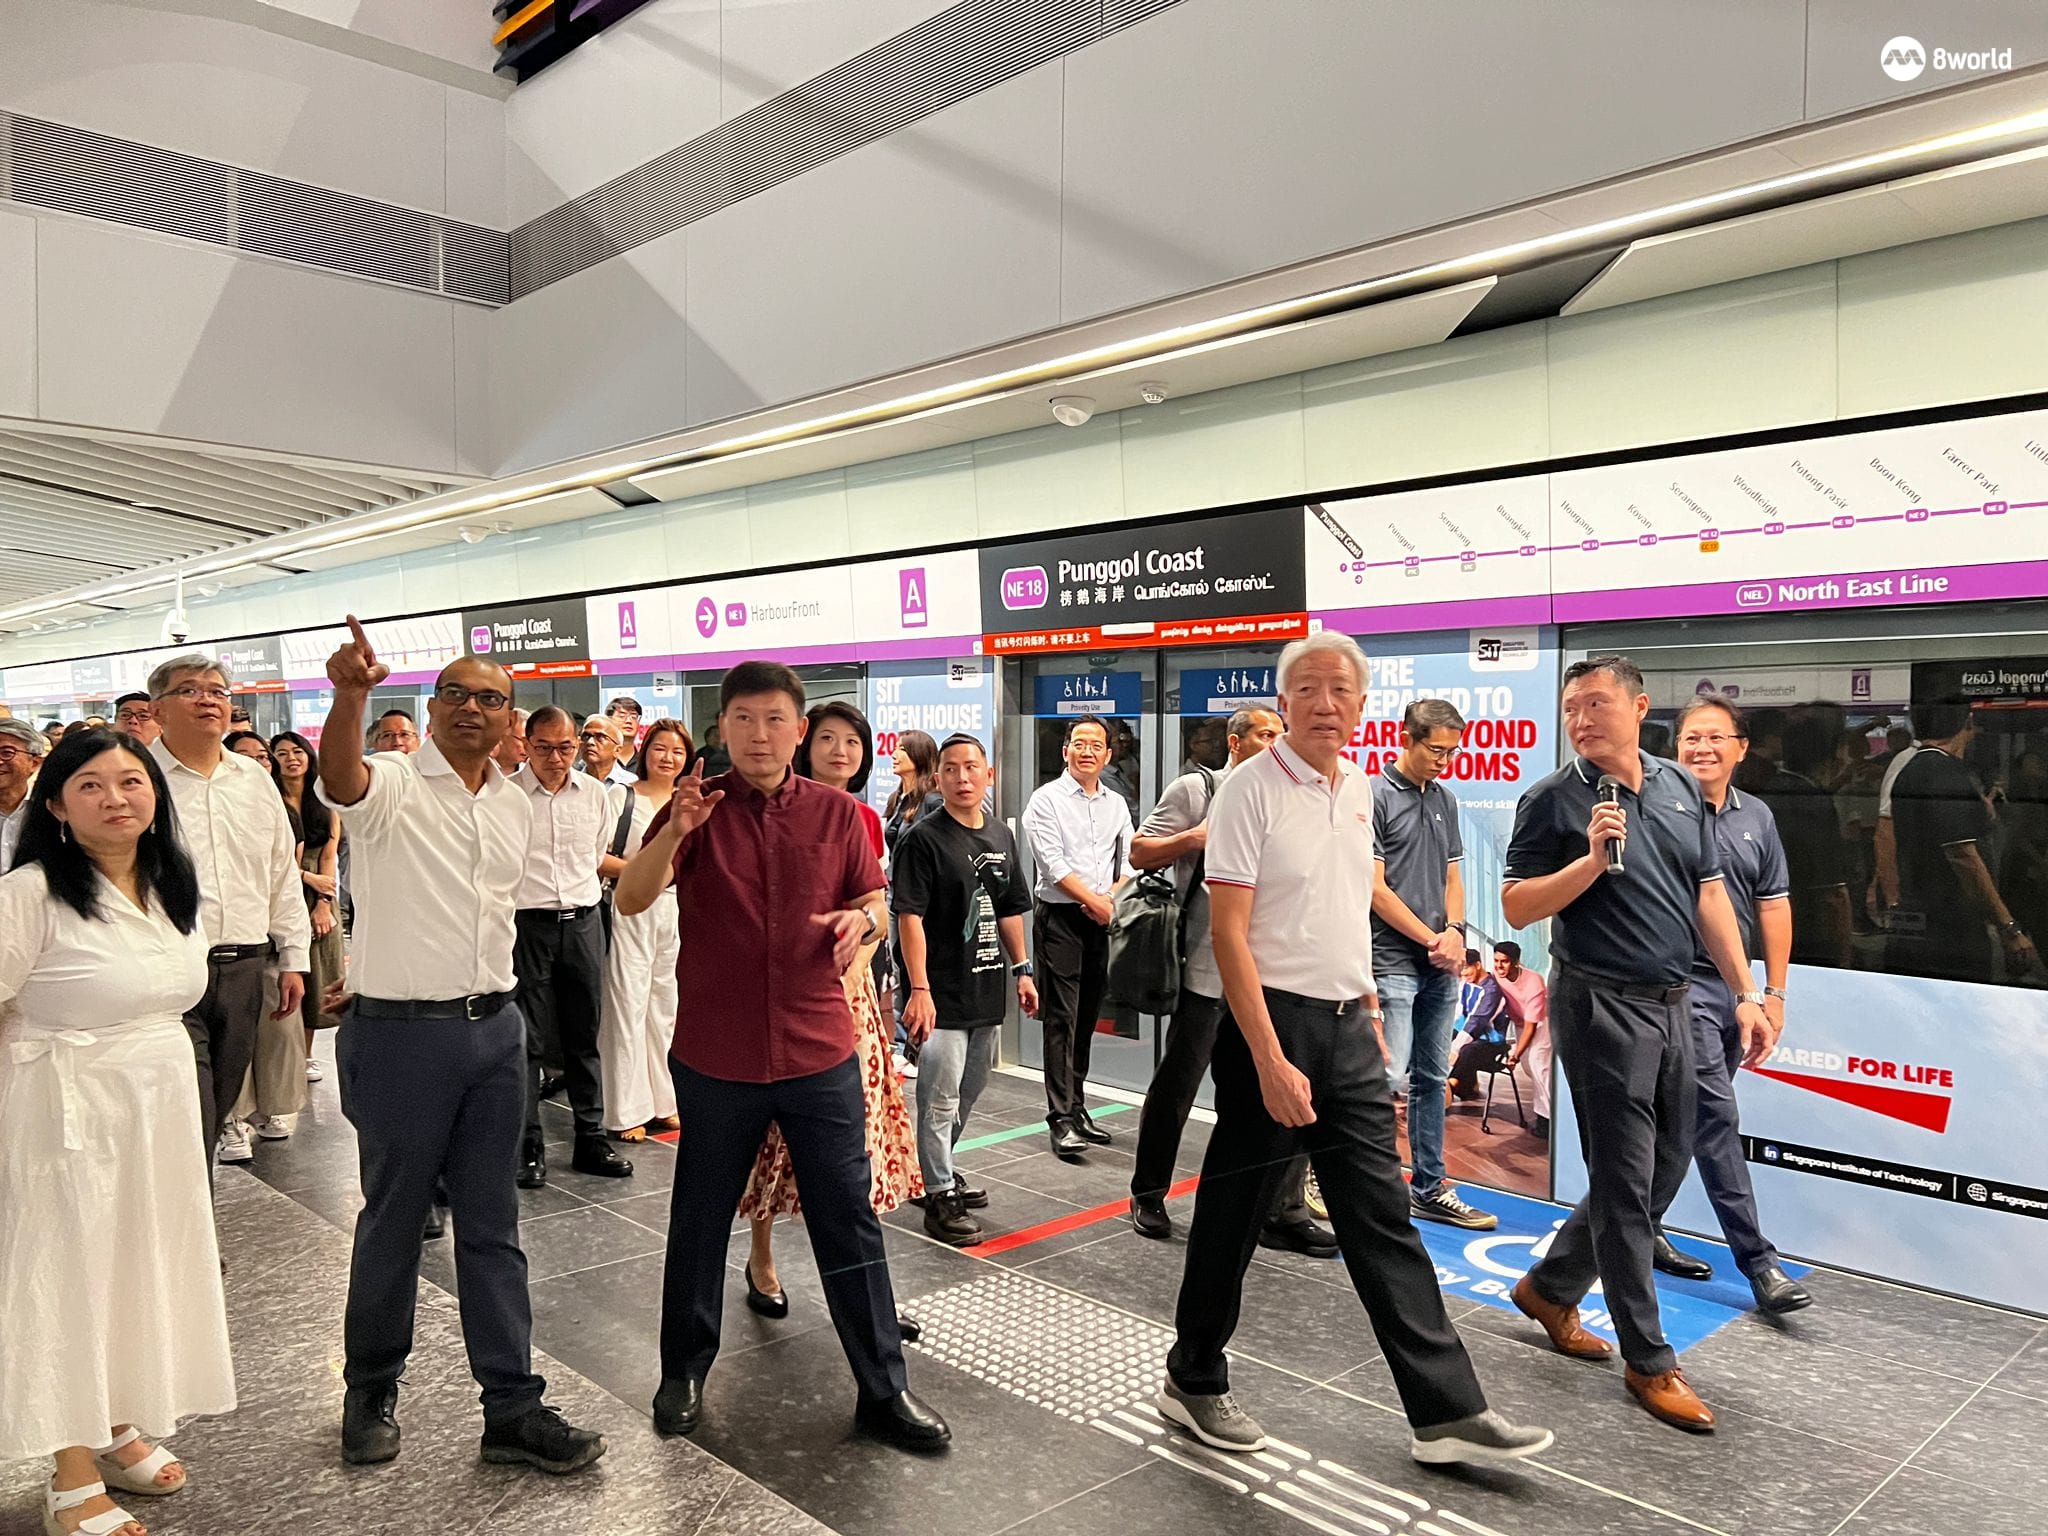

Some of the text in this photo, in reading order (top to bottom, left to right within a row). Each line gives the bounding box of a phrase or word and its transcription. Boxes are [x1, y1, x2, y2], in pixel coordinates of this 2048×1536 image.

[1791, 459, 1850, 510] Potong Pasir
[1869, 457, 1922, 504] Boon Keng
[1942, 447, 2001, 496] Farrer Park
[1669, 481, 1713, 524] Serangoon
[1732, 474, 1779, 517] Woodleigh
[1438, 511, 1472, 547] Sengkang
[1496, 504, 1532, 541] Buangkok
[1560, 500, 1595, 536] Hougang
[1627, 504, 1653, 529] Kovan
[1320, 511, 1362, 559] Punggol Coast
[1387, 522, 1416, 552] Punggol
[1058, 546, 1205, 585] Punggol Coast
[905, 578, 922, 608] A
[1743, 591, 1764, 600] NEL
[1778, 574, 1948, 602] North East Line
[622, 609, 633, 634] A
[751, 601, 820, 621] HarbourFront
[493, 618, 553, 639] Punggol Coast
[1369, 657, 1415, 687] 'RE
[876, 680, 902, 704] SIT
[1475, 686, 1513, 717] TO
[876, 704, 983, 731] OPEN HOUSE
[876, 732, 898, 757] 20
[1461, 719, 1537, 749] YOND
[1847, 1056, 1897, 1080] FOR
[1903, 1064, 1954, 1088] LIFE
[1783, 1152, 1831, 1168] Singapore
[1831, 1161, 1872, 1177] Institute
[1872, 1170, 1883, 1179] of
[1883, 1171, 1943, 1192] Technology
